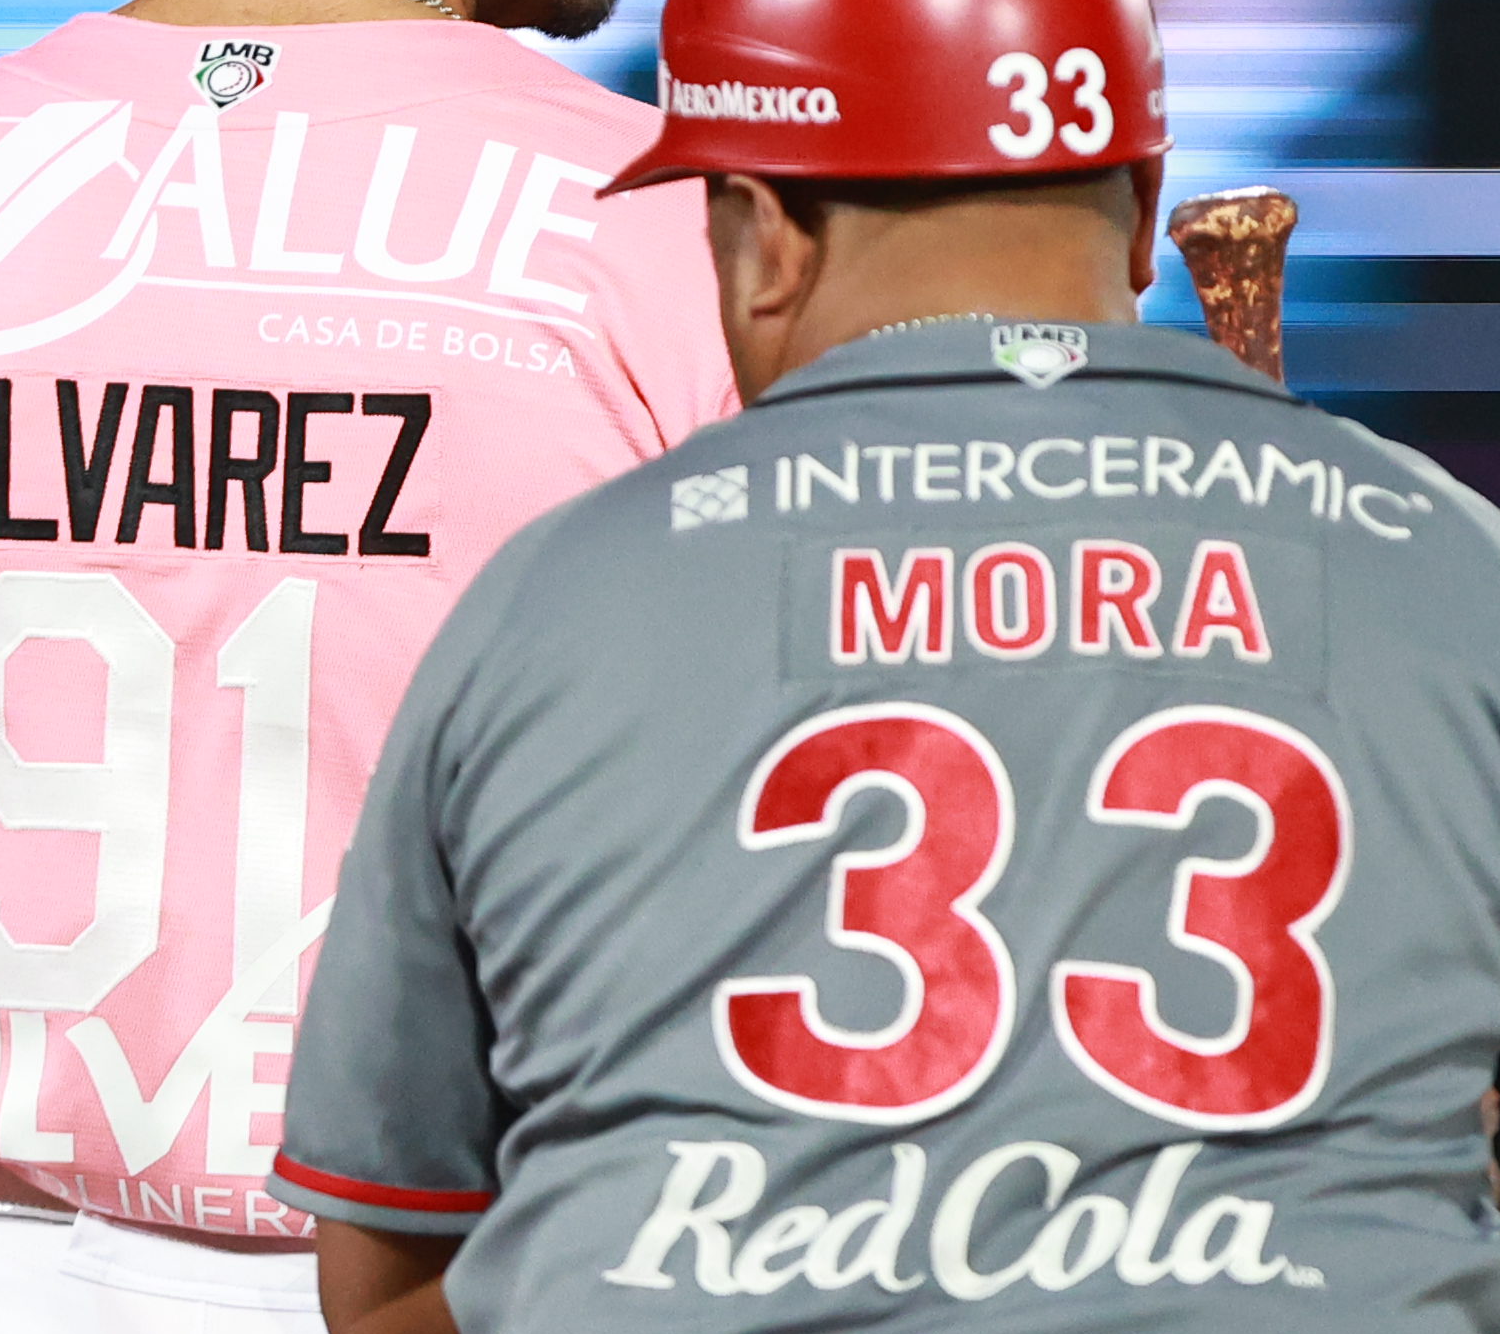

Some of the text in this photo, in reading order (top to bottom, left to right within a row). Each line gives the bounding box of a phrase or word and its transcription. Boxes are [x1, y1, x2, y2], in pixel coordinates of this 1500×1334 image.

[200, 42, 274, 67] LMB
[672, 78, 842, 125] AEROMEXICO
[987, 48, 1114, 158] 33
[258, 314, 577, 378] CASA DE BOLSA
[774, 435, 1416, 539] INTERCERAMIC
[831, 538, 1272, 664] MORA
[712, 701, 1354, 1131] 33
